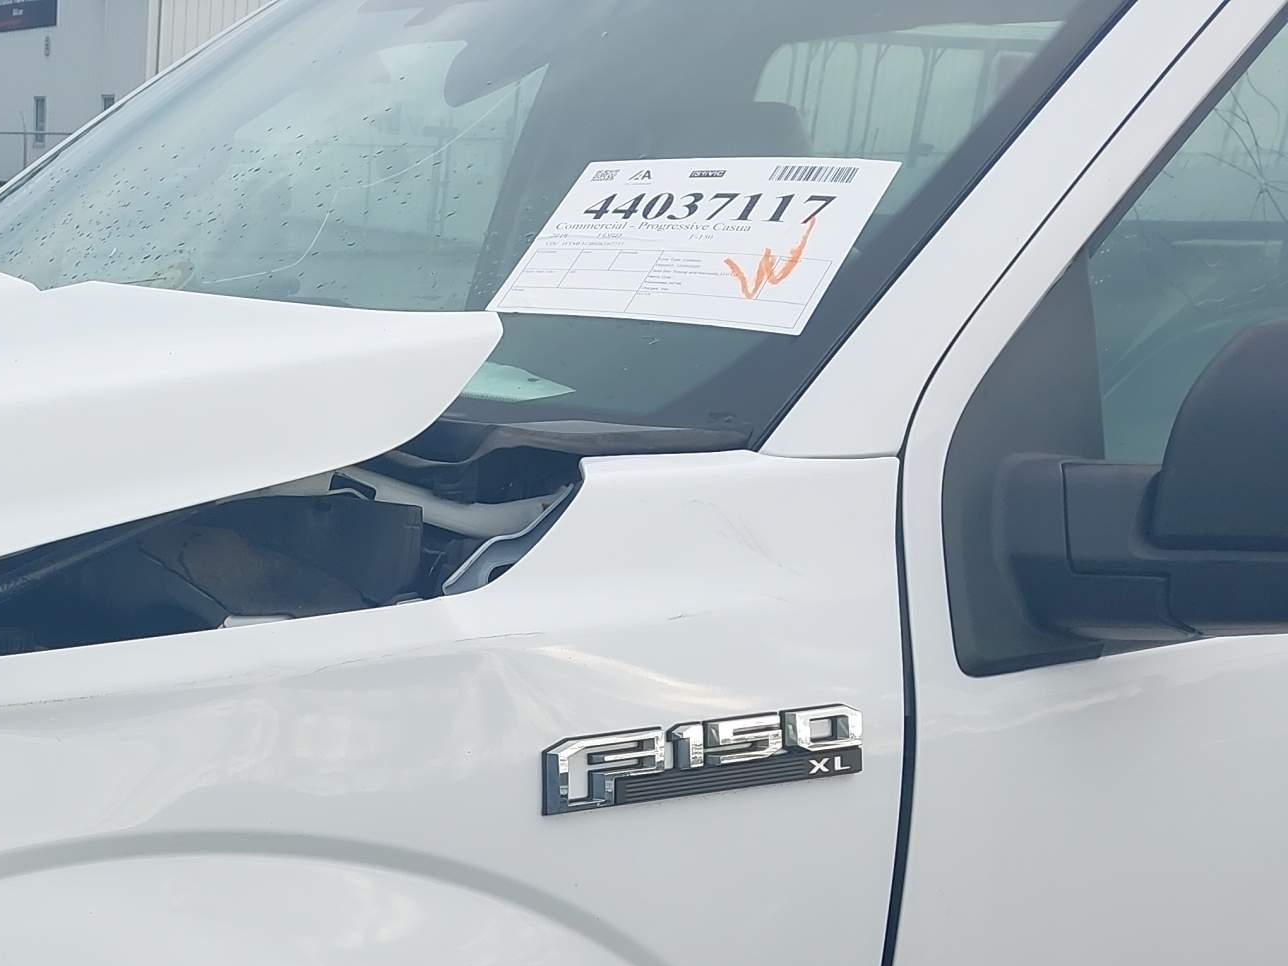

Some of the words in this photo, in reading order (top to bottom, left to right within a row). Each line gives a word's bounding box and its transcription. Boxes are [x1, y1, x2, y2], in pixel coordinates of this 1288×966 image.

[583, 191, 838, 225] 44037117
[556, 221, 627, 231] Commercial
[635, 221, 710, 234] Progressive
[809, 756, 851, 774] XL
